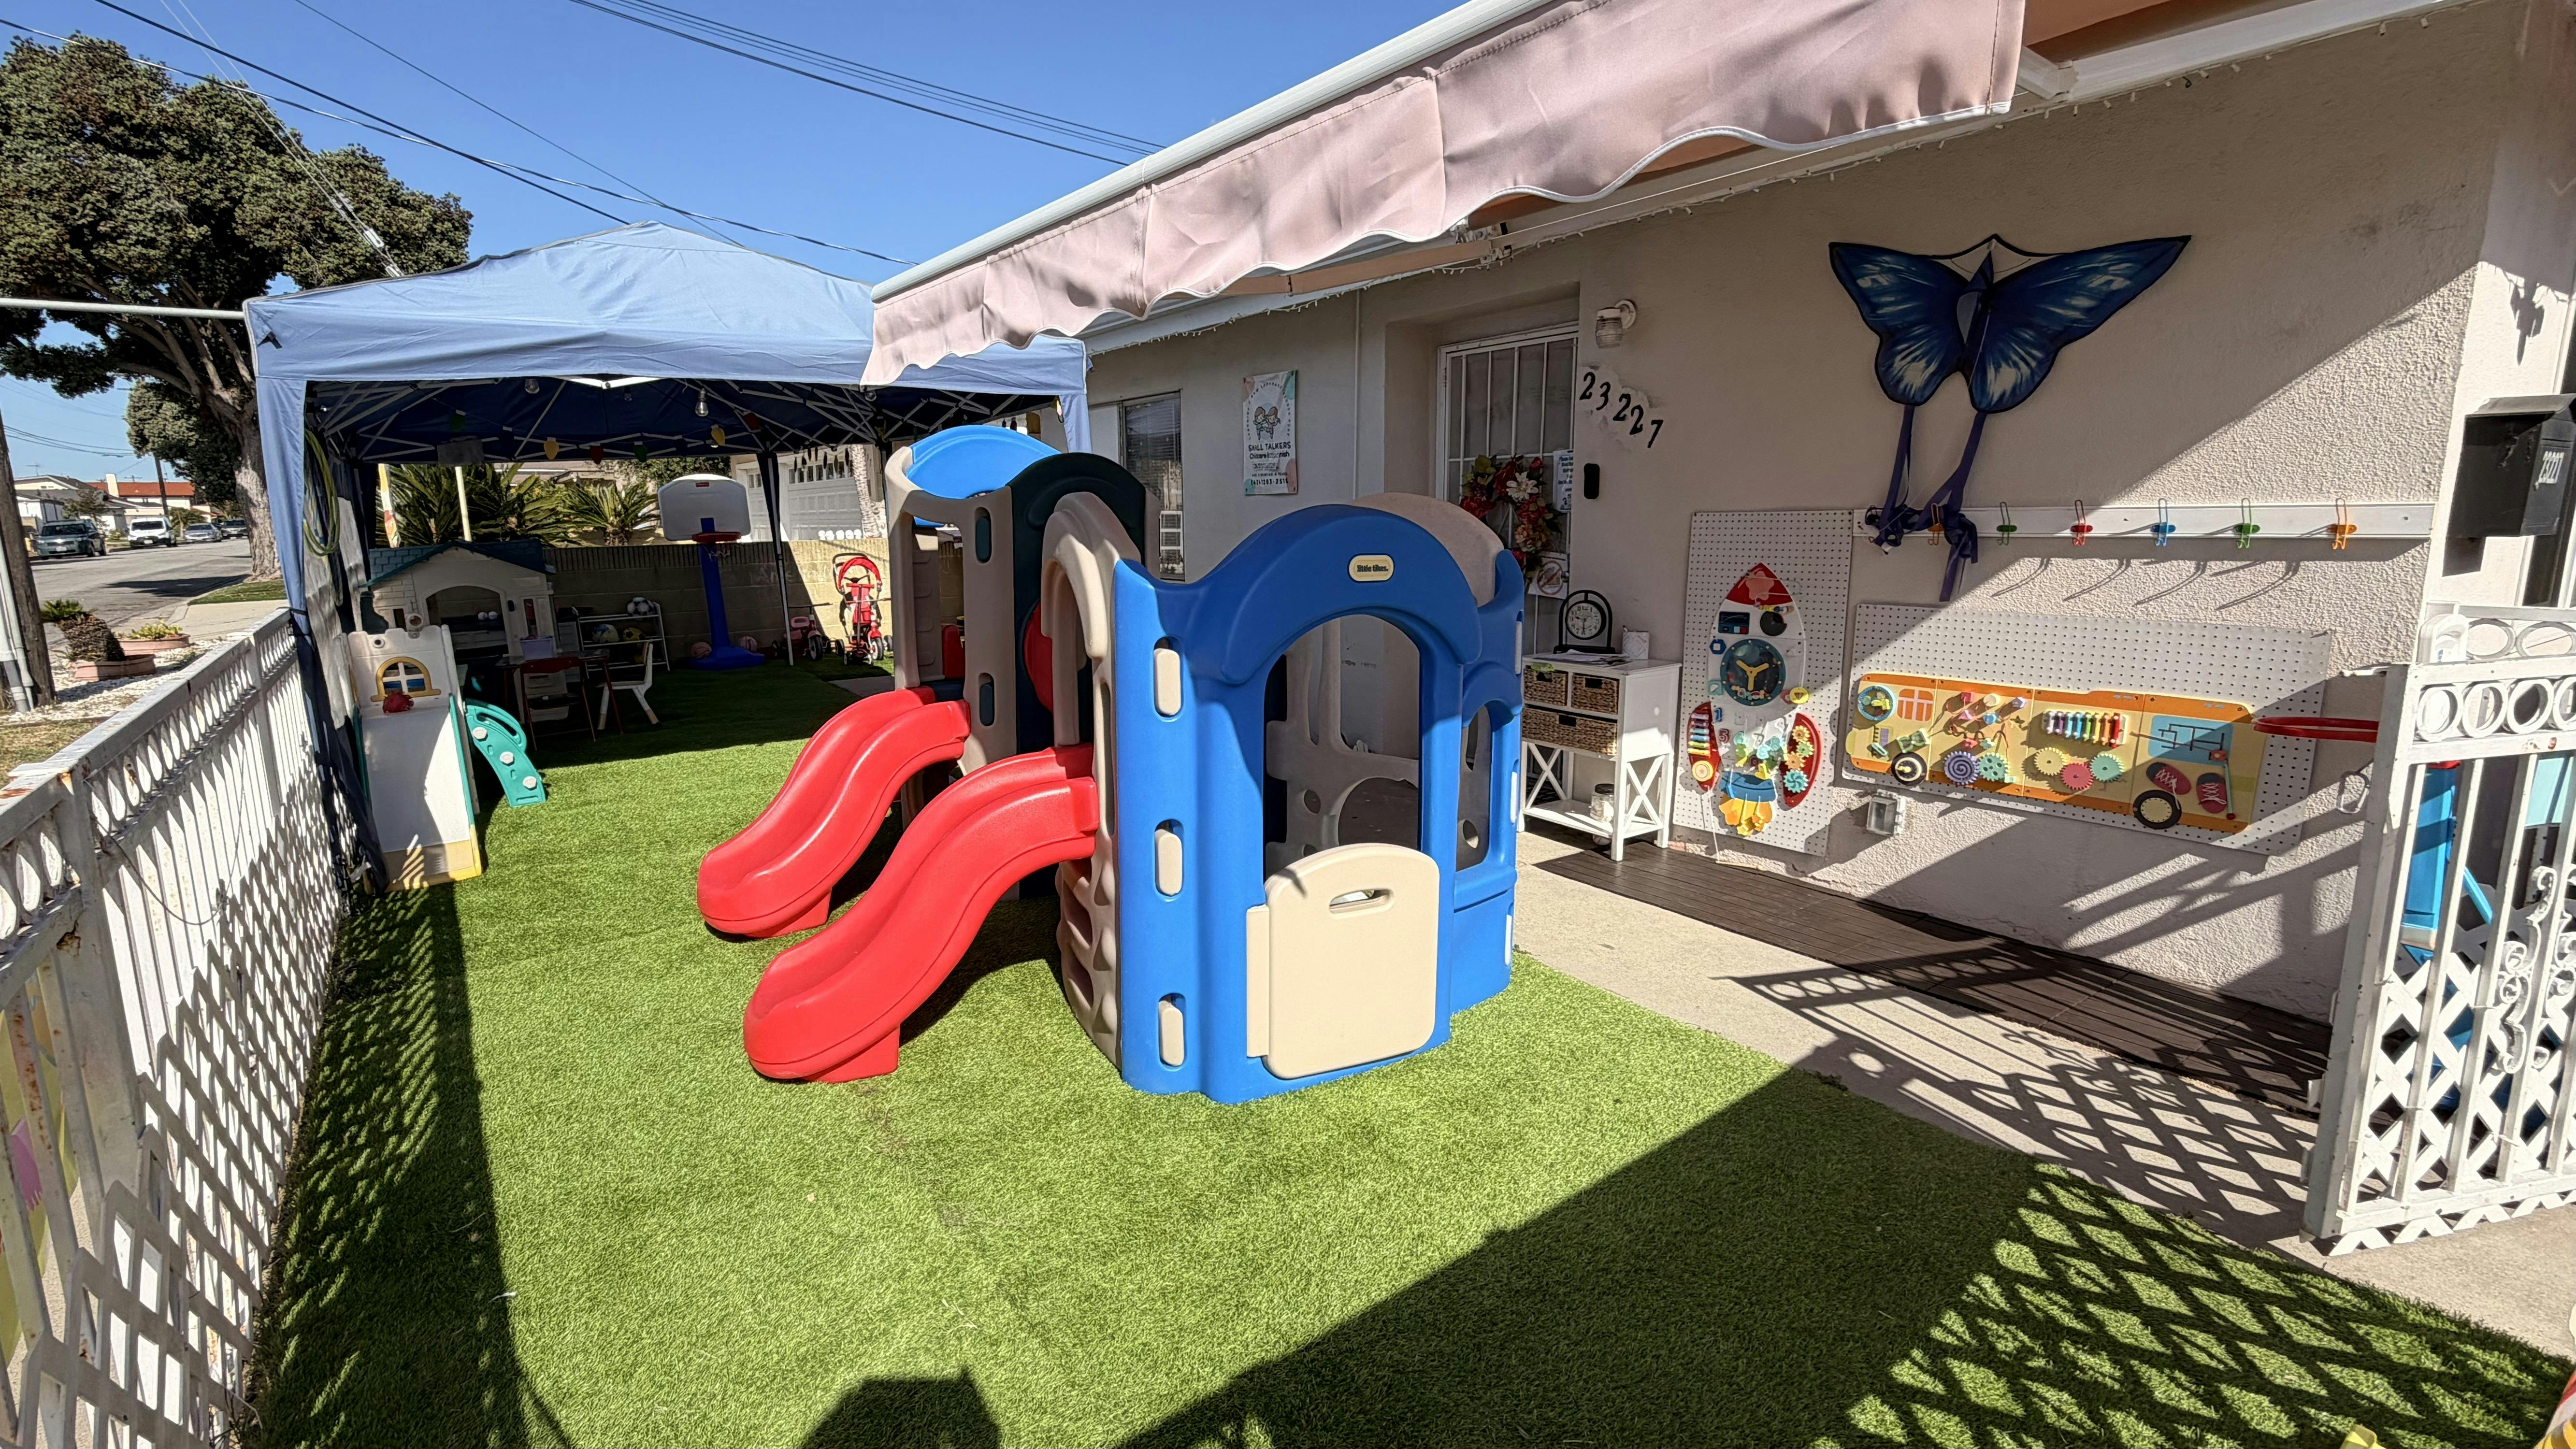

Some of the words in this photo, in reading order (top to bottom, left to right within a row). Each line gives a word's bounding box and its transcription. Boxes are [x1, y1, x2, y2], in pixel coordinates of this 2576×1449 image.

[1579, 372, 1664, 448] 23227
[1265, 441, 1292, 450] TALKERS
[2538, 451, 2565, 484] 23227
[1713, 707, 1723, 723] 1
